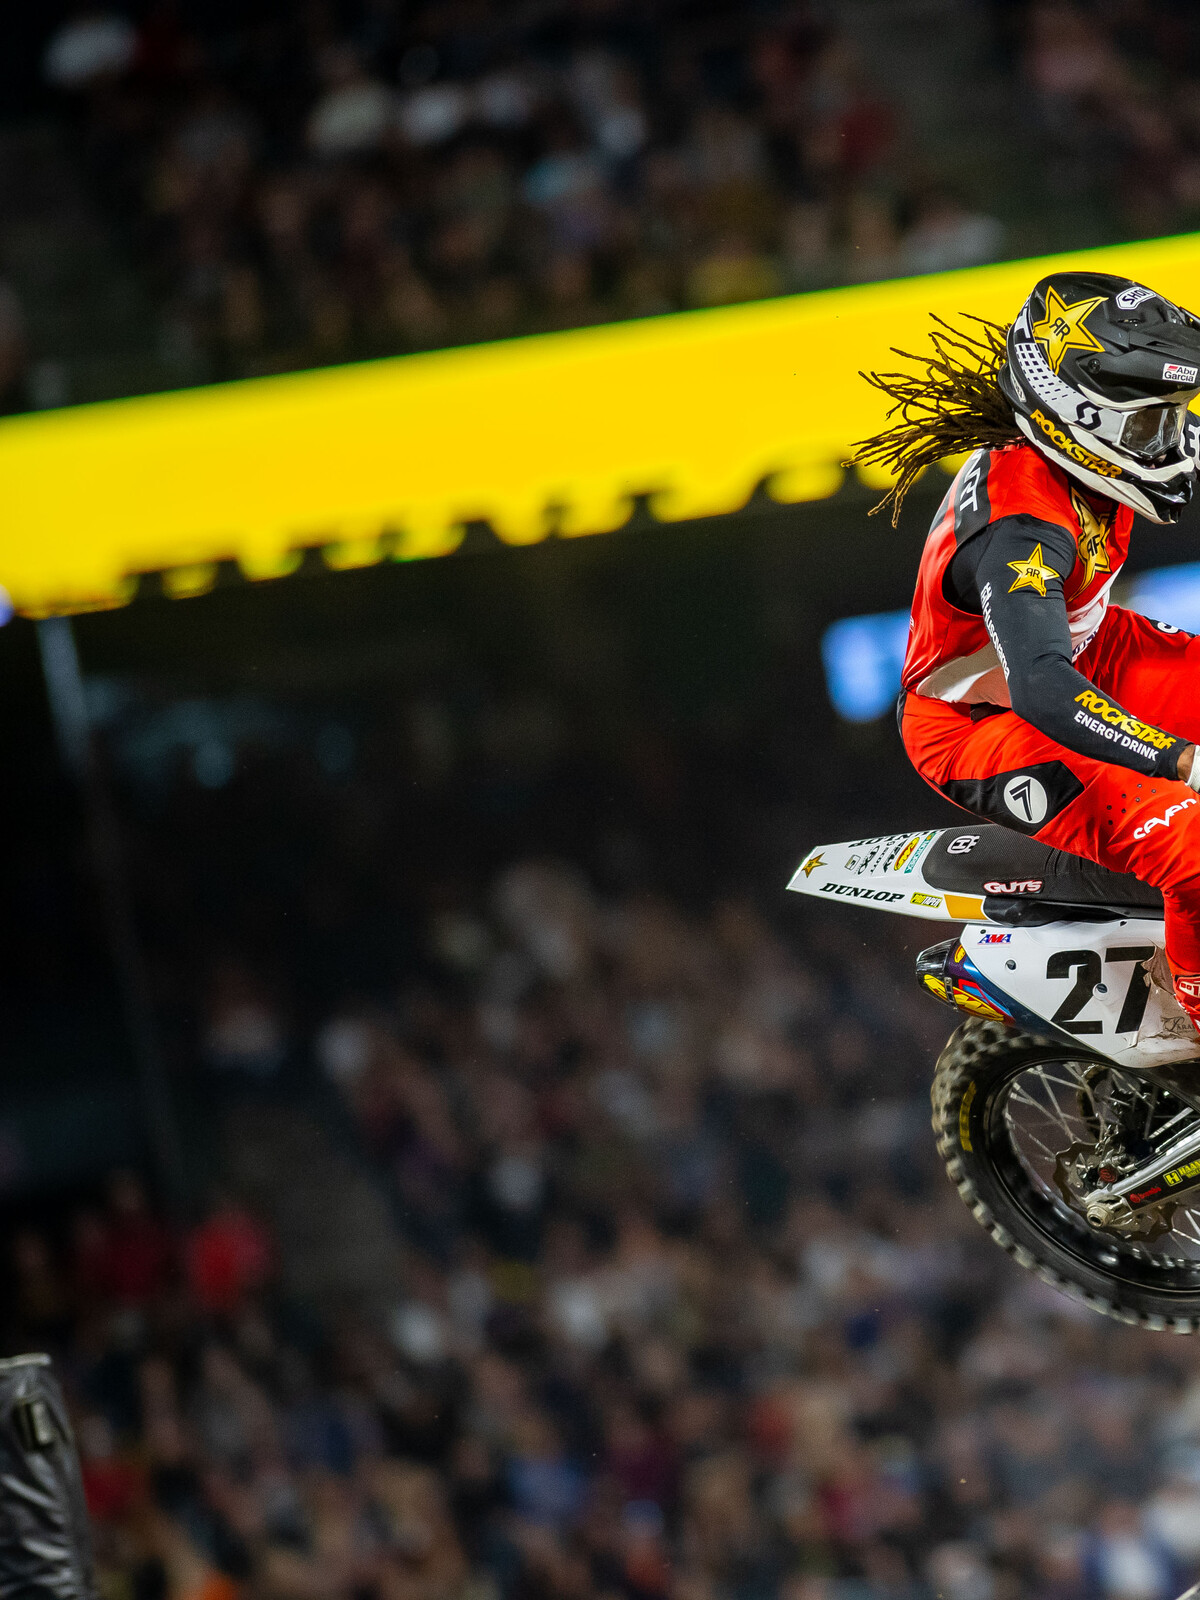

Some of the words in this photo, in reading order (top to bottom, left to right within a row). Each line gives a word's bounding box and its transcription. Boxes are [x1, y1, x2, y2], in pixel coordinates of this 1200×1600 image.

[1164, 371, 1194, 383] Garcia
[1176, 366, 1196, 376] Abu
[1030, 408, 1123, 478] ROCKSTAR
[1073, 710, 1123, 743] ENERGY
[1120, 736, 1160, 762] DRINK
[819, 883, 906, 902] DUNLOP
[983, 880, 1043, 894] GUTS
[977, 934, 1012, 945] AMA
[1046, 945, 1156, 1034] 27
